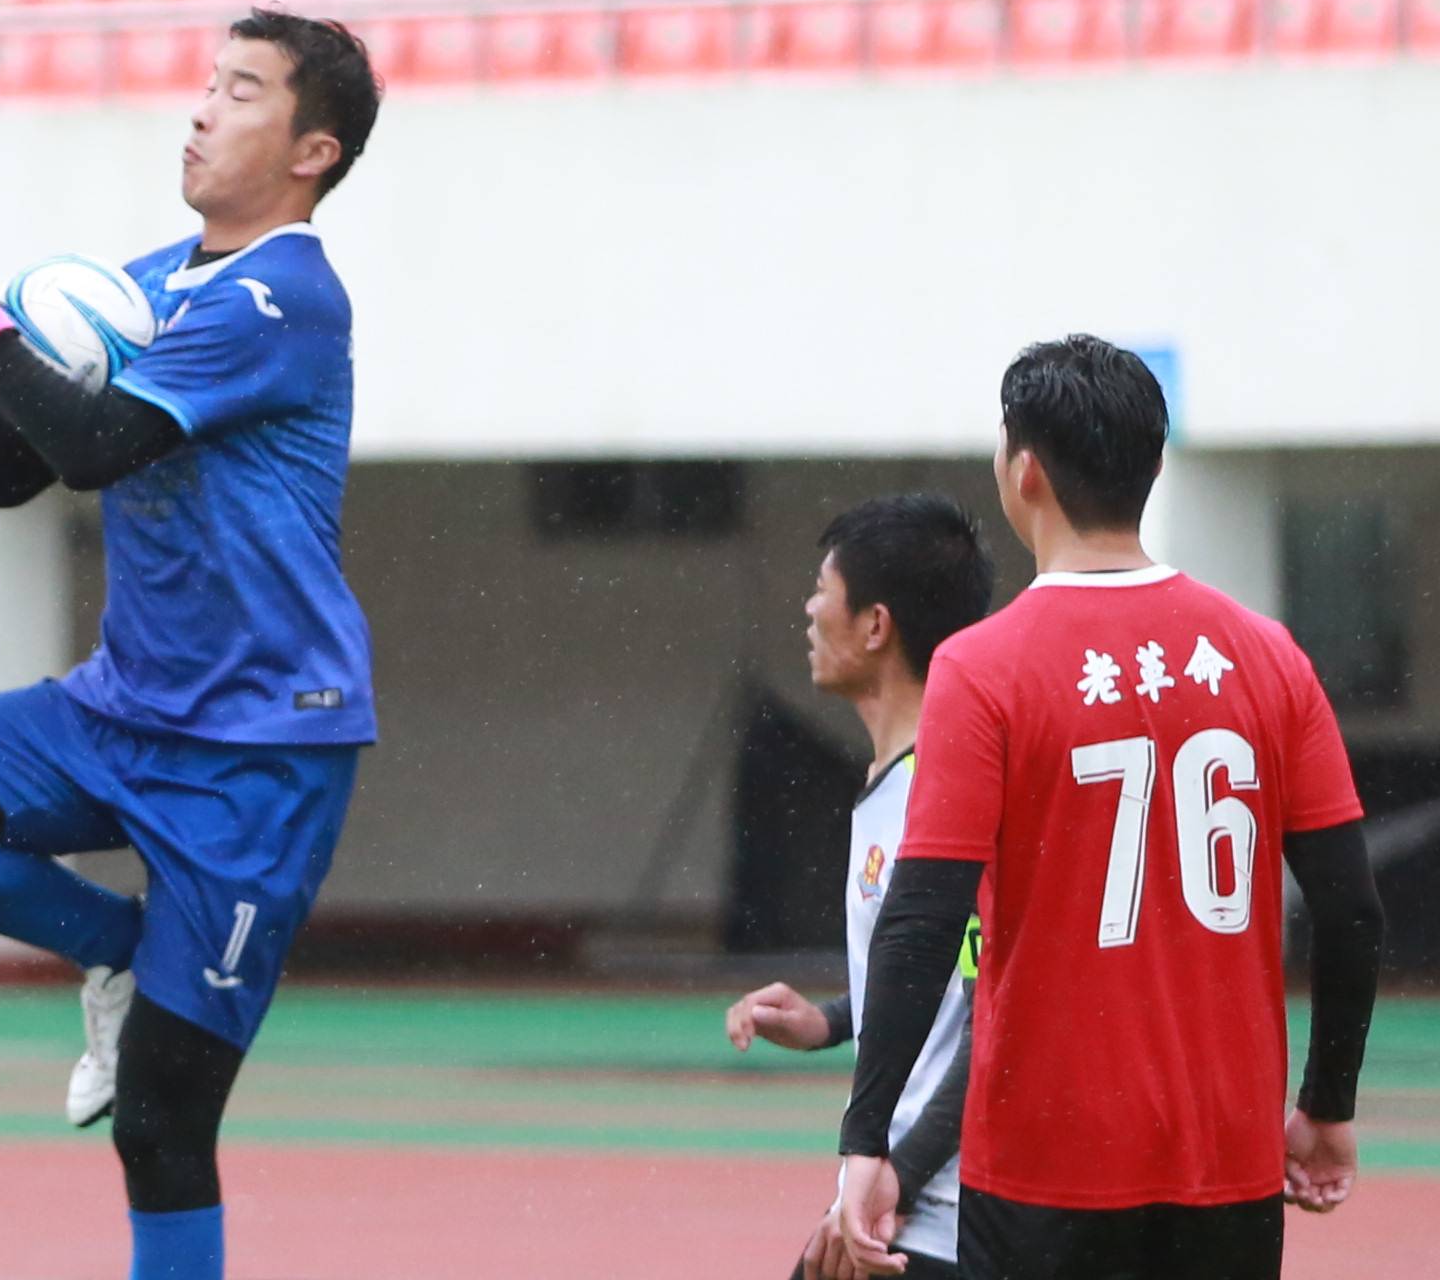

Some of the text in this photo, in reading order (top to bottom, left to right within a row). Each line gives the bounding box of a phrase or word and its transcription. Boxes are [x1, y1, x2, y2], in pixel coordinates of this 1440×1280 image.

[1076, 634, 1235, 707] 老革命
[1071, 727, 1261, 949] 76
[222, 901, 258, 974] 1
